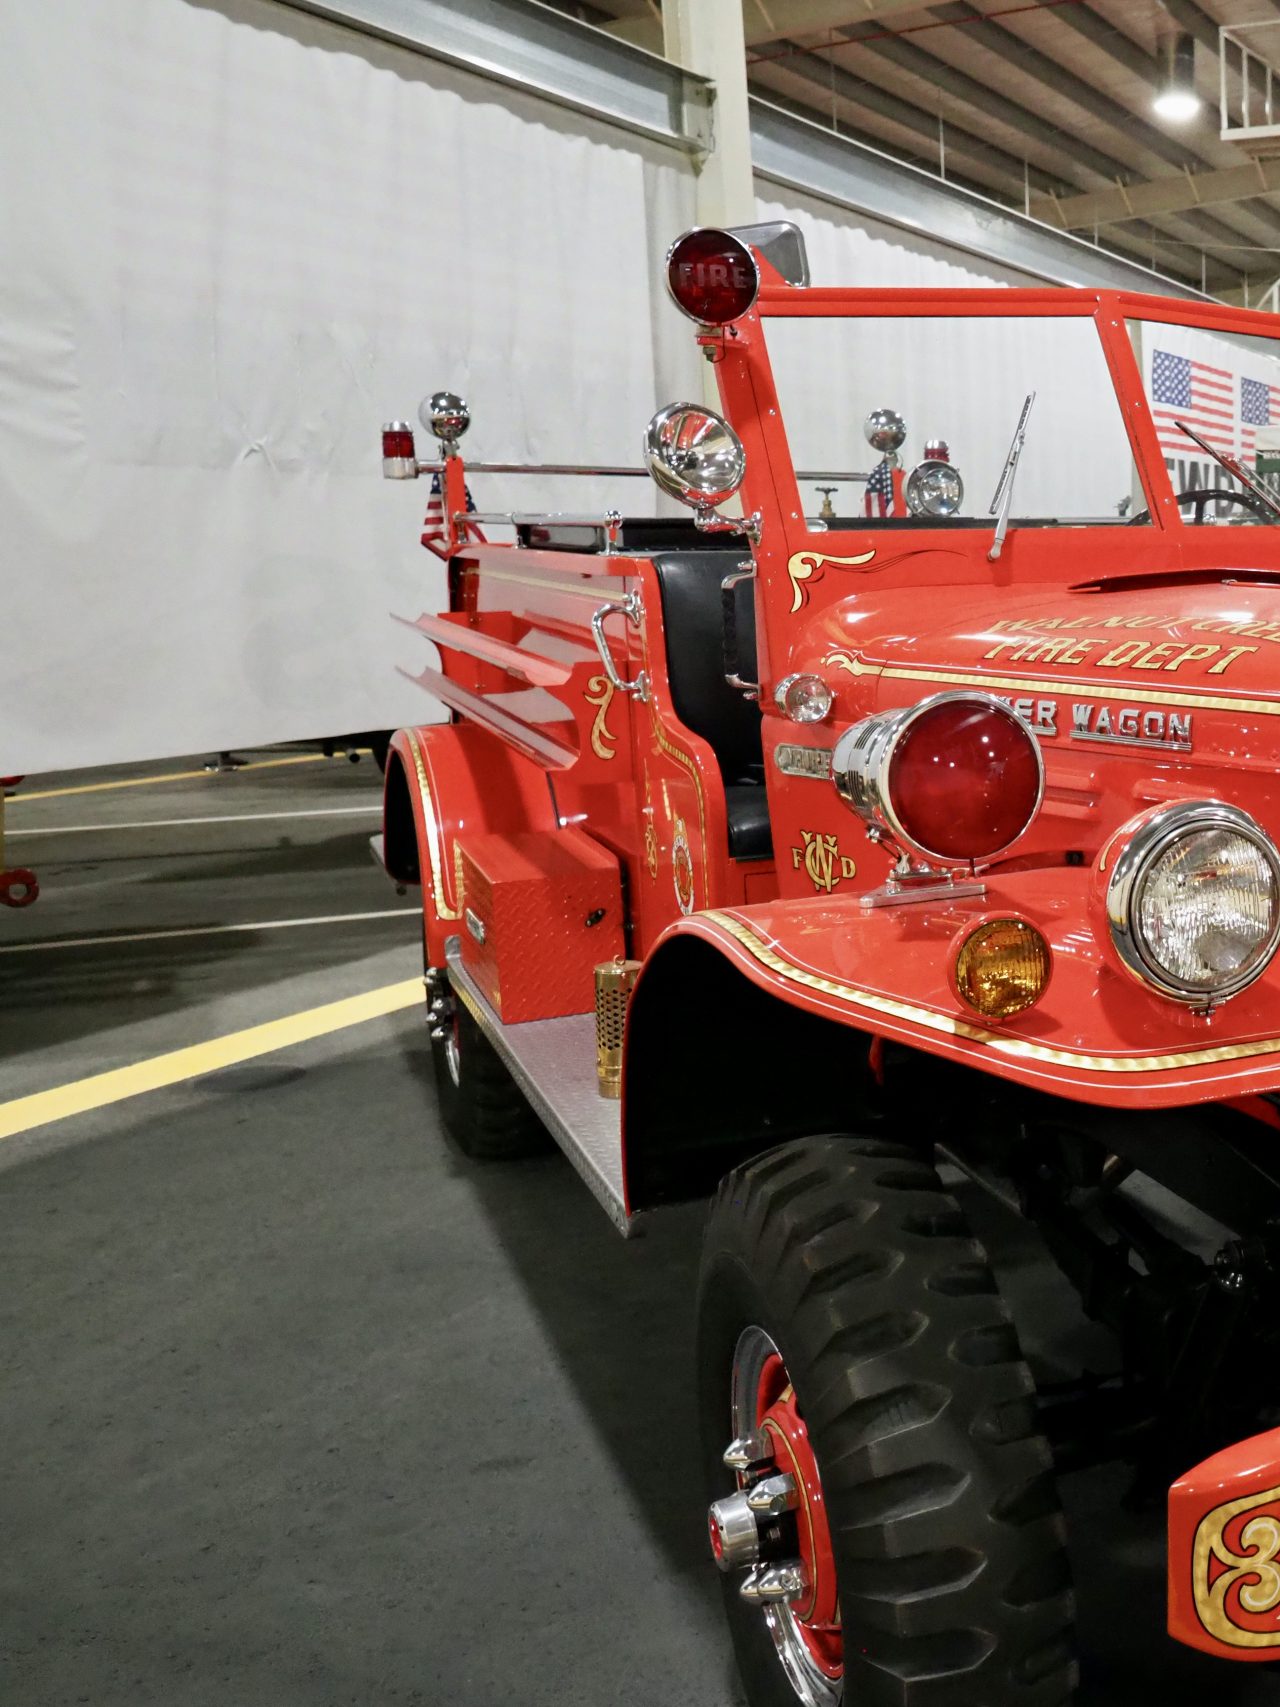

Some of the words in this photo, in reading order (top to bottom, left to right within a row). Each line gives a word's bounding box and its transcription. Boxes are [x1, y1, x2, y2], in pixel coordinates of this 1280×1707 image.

[678, 262, 748, 289] FIRE
[982, 616, 1200, 635] WALNUT
[983, 635, 1110, 665] FIRE
[1095, 640, 1260, 674] DEPT
[1072, 703, 1193, 742] WAGON
